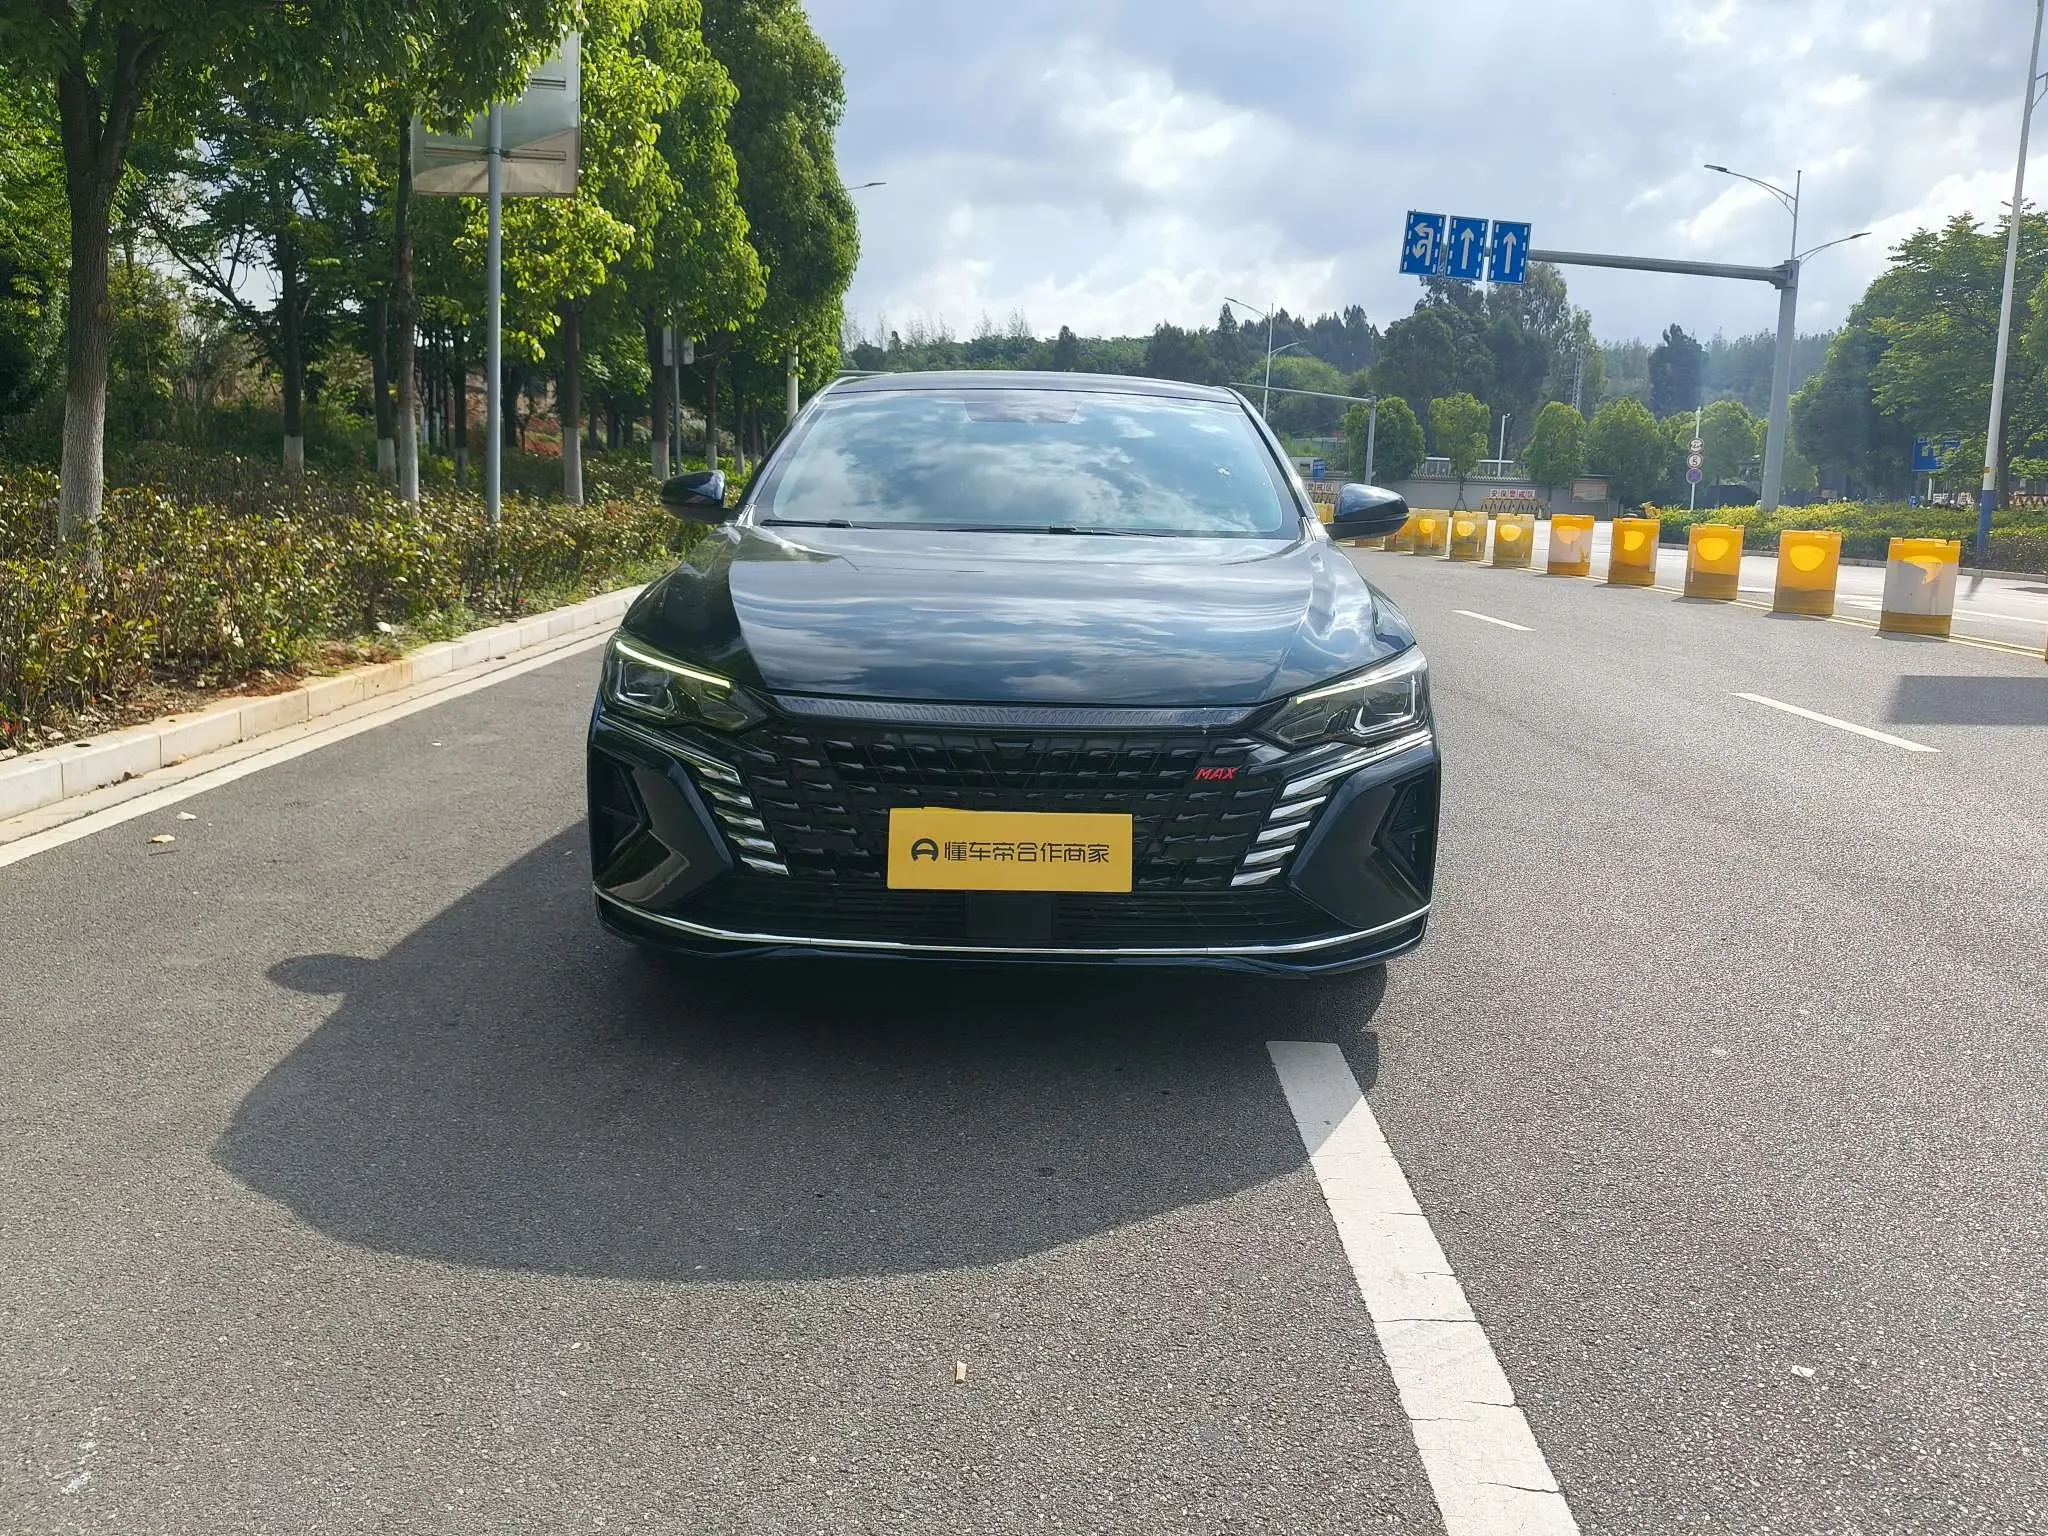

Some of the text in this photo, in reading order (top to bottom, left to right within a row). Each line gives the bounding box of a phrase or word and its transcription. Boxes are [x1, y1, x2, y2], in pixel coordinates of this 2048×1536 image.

[1193, 767, 1239, 781] MAX
[943, 841, 1110, 863] 懂车帝合作商家
